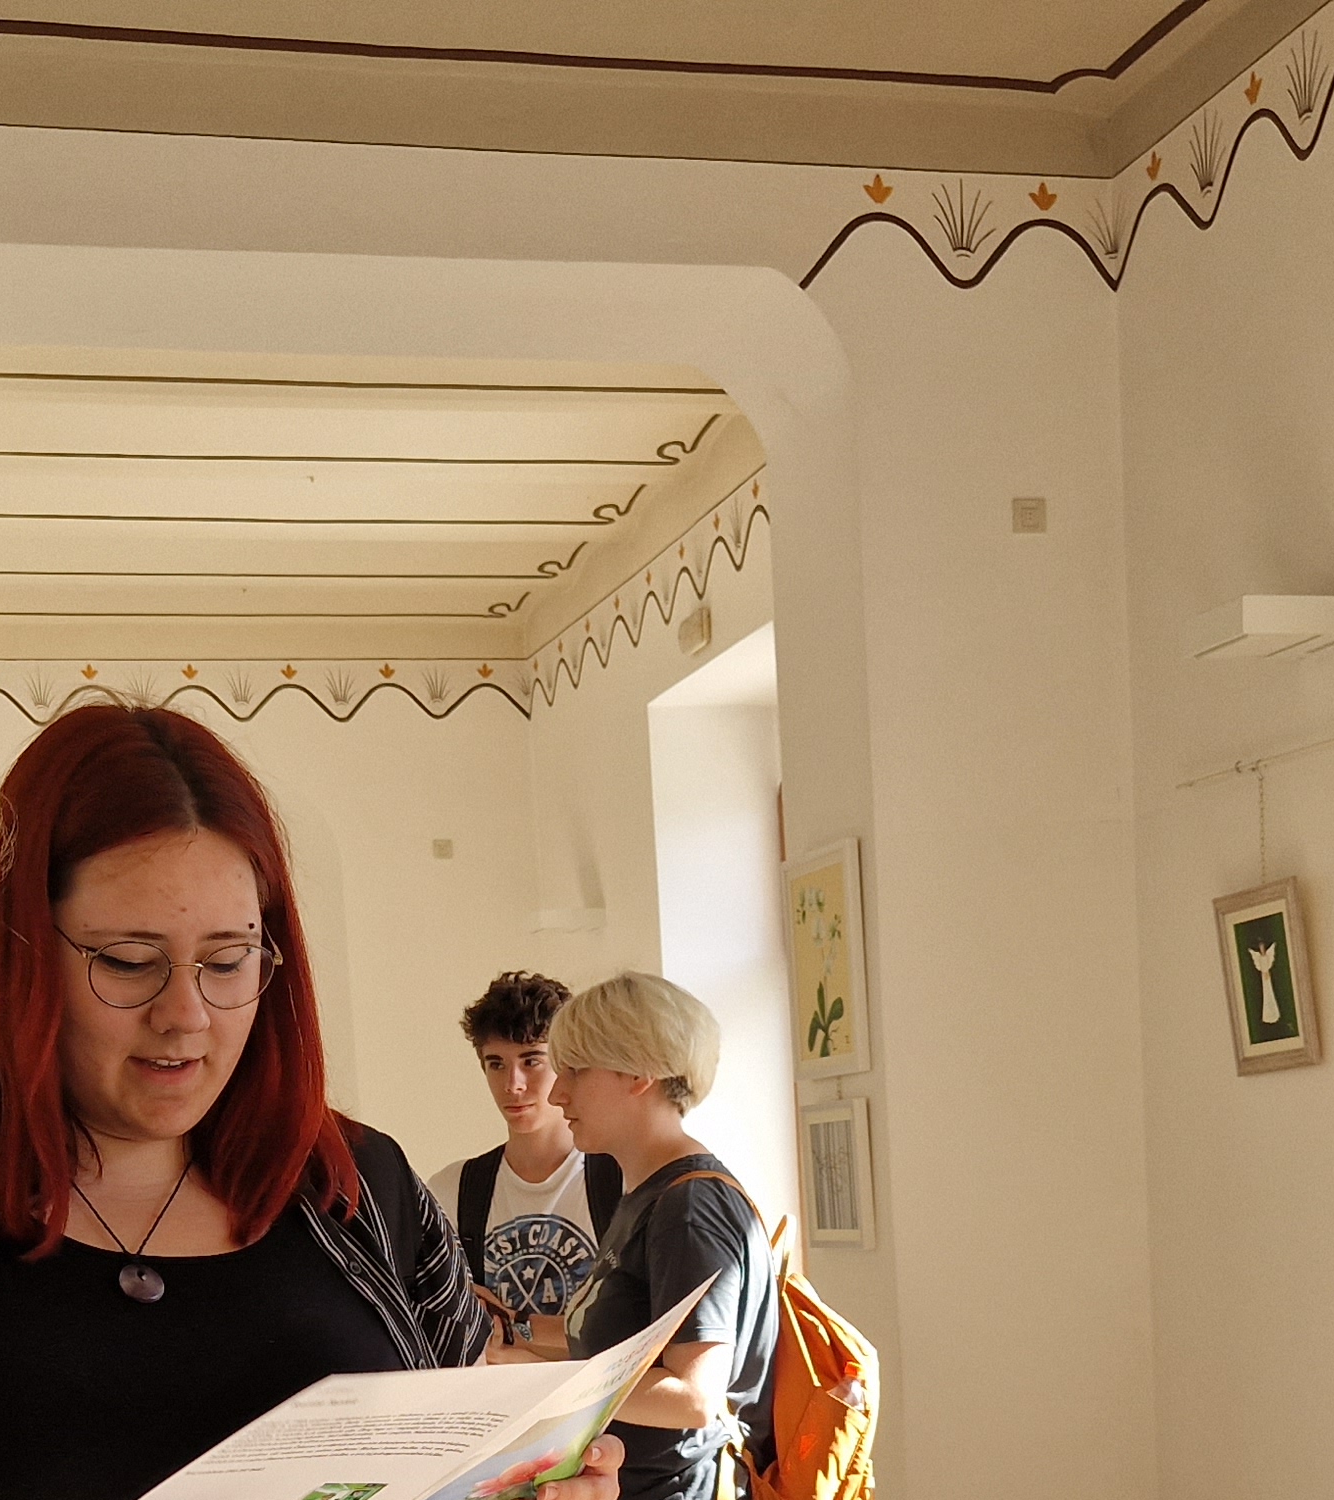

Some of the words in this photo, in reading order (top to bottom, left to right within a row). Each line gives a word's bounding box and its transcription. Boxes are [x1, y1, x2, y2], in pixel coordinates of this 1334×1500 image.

[484, 1229, 520, 1273] WEST
[528, 1224, 589, 1266] COAST
[541, 1277, 558, 1304] A
